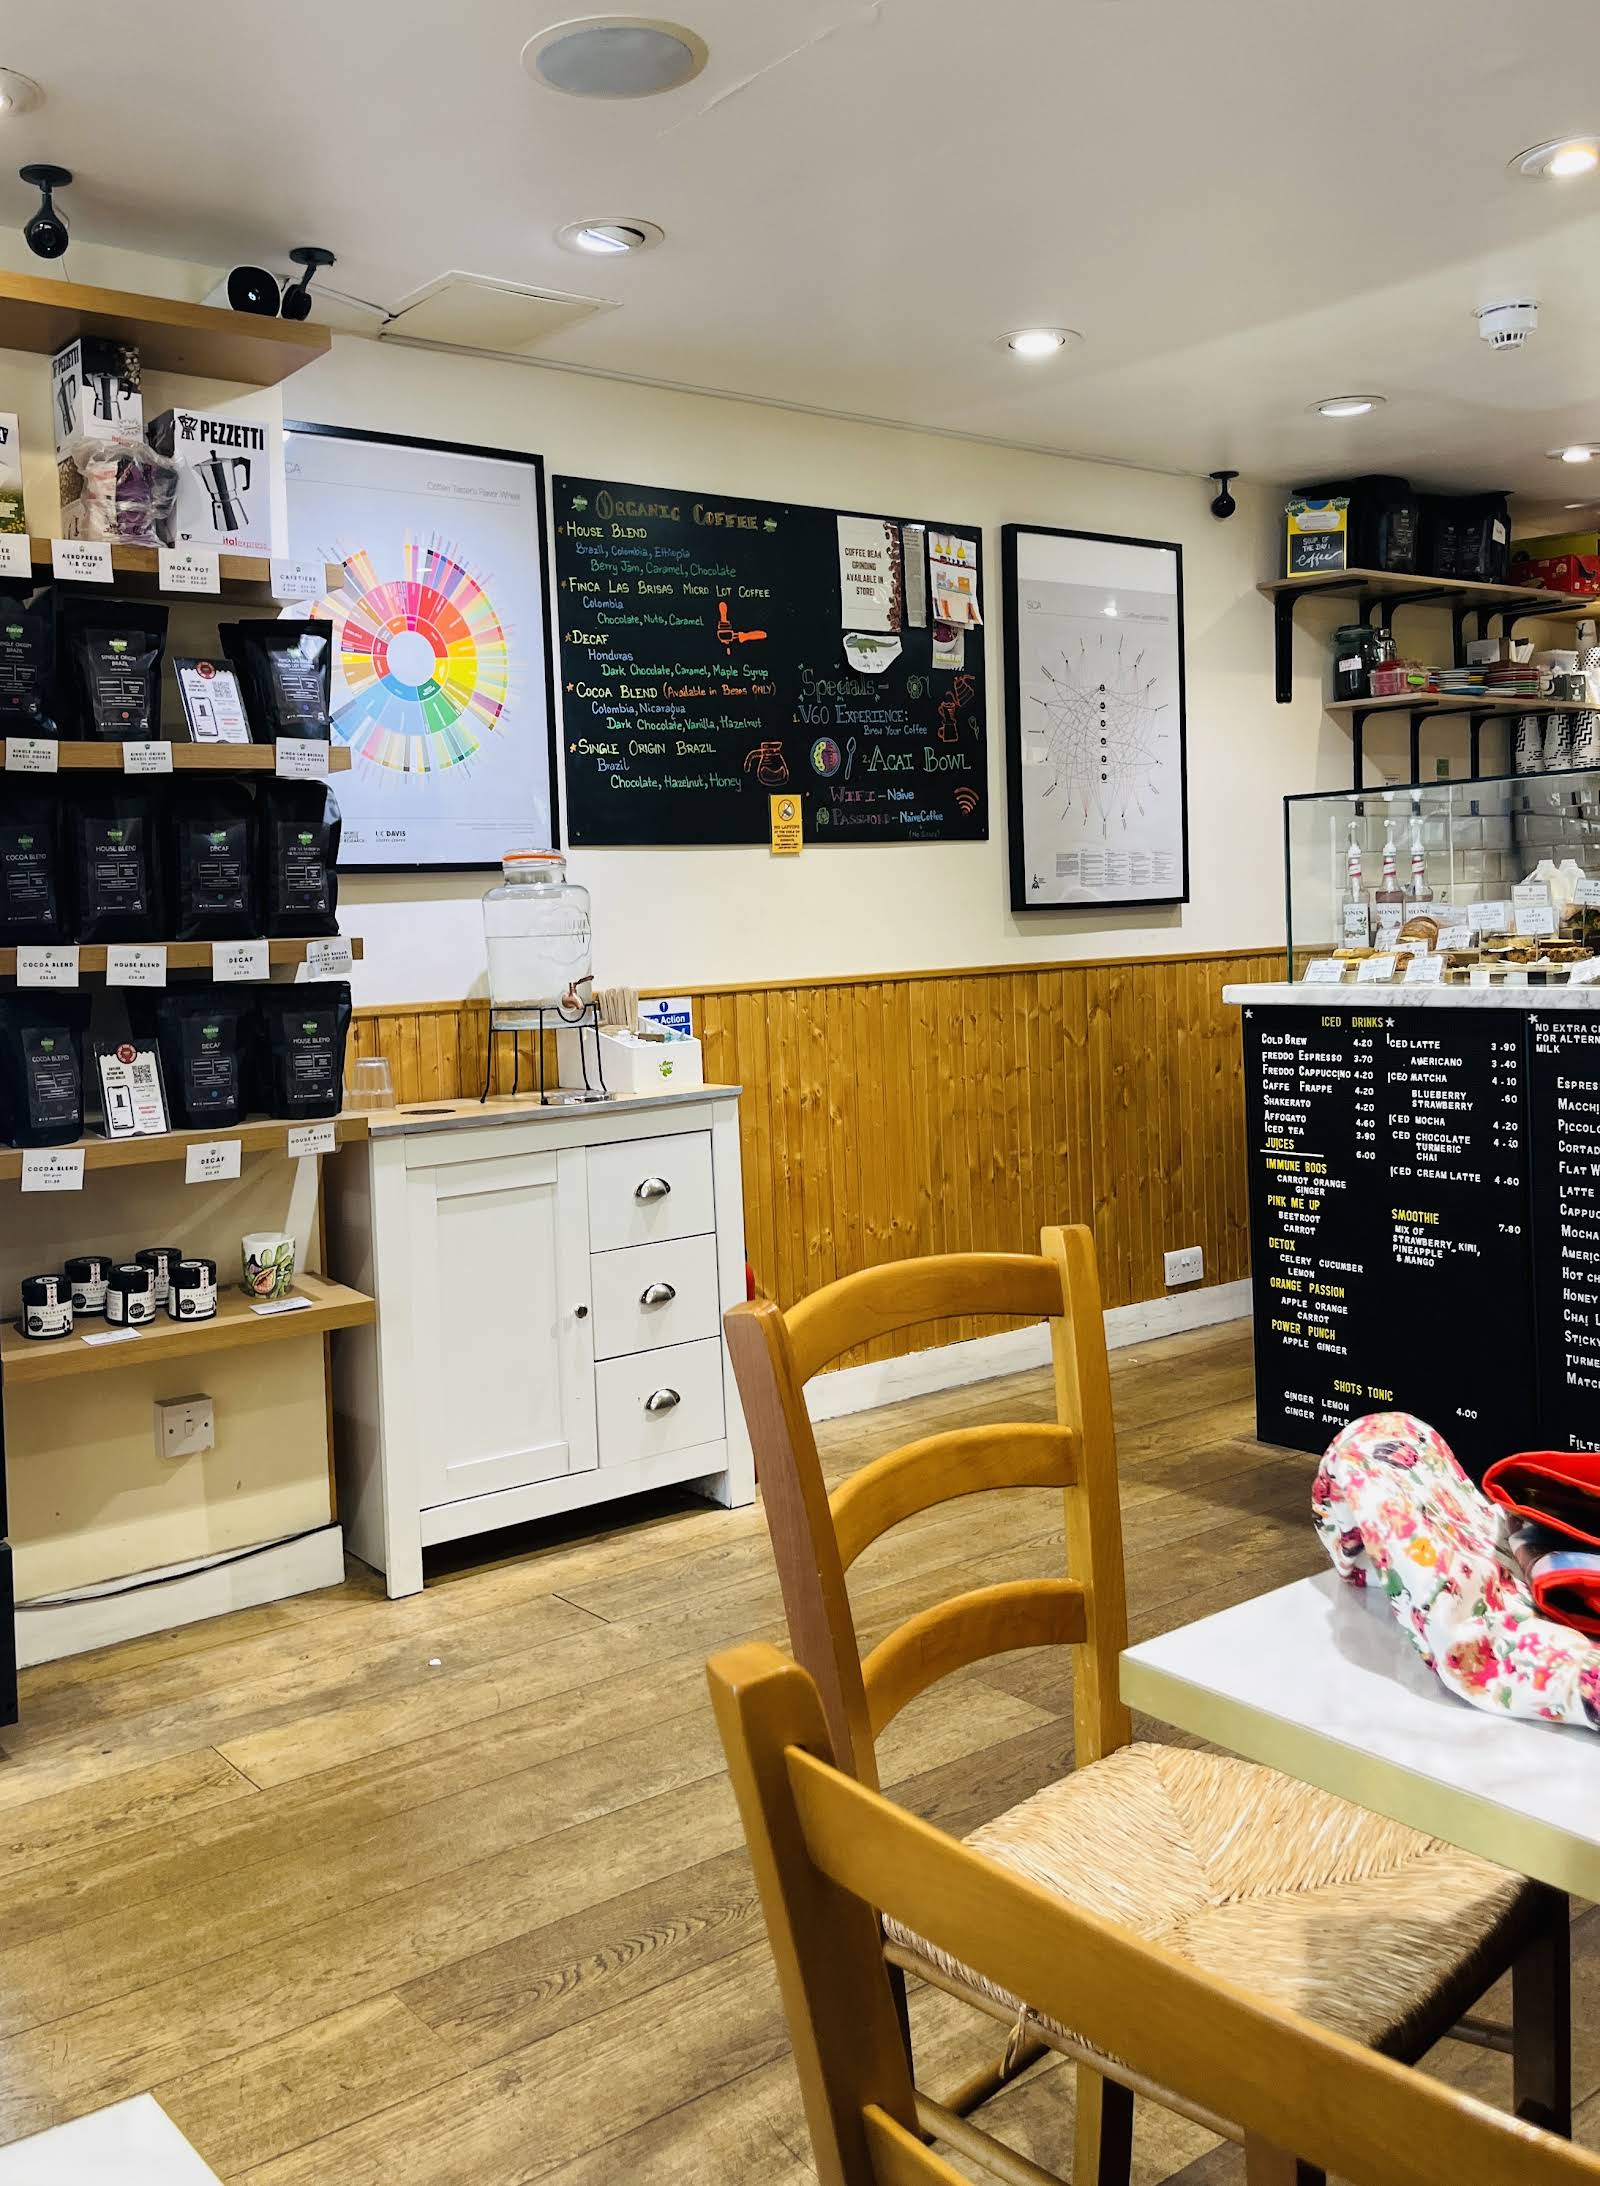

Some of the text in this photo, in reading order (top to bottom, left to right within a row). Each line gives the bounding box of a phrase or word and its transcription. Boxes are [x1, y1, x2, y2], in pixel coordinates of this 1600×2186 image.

[201, 420, 264, 450] PEZZETTI
[595, 490, 758, 530] ORGANIC COFFEE
[567, 521, 647, 538] HOUSE BLEND
[845, 548, 881, 558] COFFEE BEAN
[1296, 550, 1342, 567] Coffee
[591, 560, 736, 577] Berry Chocolate
[852, 562, 876, 570] GRINDING
[847, 574, 877, 583] AVAILABLE
[569, 578, 770, 598] FINCA LAS BRISAS MICRO LOT COFFEE
[583, 596, 624, 609] Colombia
[598, 613, 704, 626] Chocolate, Caramel
[572, 630, 609, 645] DECAF
[588, 649, 633, 661] Honduras
[601, 665, 768, 680] Dark Chocolate, Maple Syrup
[576, 682, 657, 698] COCOA BLEND
[592, 702, 686, 720] Colombia, Nicaragua
[607, 717, 762, 732] Dark Chocolate, Hazelnut
[904, 725, 927, 734] Coffee
[578, 739, 716, 755] SINGLE ORIGIN BRAZIL
[598, 758, 630, 772] Brazil
[923, 747, 971, 772] BOWL
[611, 774, 741, 792] Chocolate, Honey
[661, 1016, 685, 1024] Action
[1322, 1016, 1383, 1028] ICED DRINKS
[1553, 1024, 1587, 1032] EXTRA
[1262, 1033, 1307, 1045] COLD BREW
[1353, 1039, 1372, 1047] 4.20
[1410, 1041, 1440, 1049] LATTE
[1537, 1034, 1556, 1043] FOR
[1536, 1044, 1560, 1053] MILK
[1262, 1050, 1373, 1063] FREDDO ESPRESSO 3.70
[1411, 1057, 1463, 1066] AMERICANO
[1263, 1064, 1373, 1080] FREDDO CAPPUCCINO 4.20
[1410, 1073, 1447, 1083] MATCHA
[1263, 1079, 1374, 1095] CAFFE FRAPPE 4.20
[1412, 1090, 1467, 1100] BLUEBERRY
[1263, 1095, 1374, 1111] SHAKERATO 4.20
[1412, 1100, 1473, 1111] STRAWBERRY
[1264, 1110, 1375, 1128] AFFOGATO 4.60
[1415, 1116, 1445, 1126] MOCHA
[1265, 1122, 1375, 1140] ICED TEA 3.90
[1415, 1133, 1471, 1144] CHOCOLATE
[1265, 1137, 1375, 1160] JUICES 6.00
[1416, 1143, 1461, 1153] TURMERIC
[1416, 1153, 1438, 1161] CHAI
[1266, 1158, 1327, 1174] IMMUNE BOOS
[1277, 1175, 1346, 1189] CARROT ORANGE
[1417, 1169, 1481, 1183] CREAM LATTE
[1295, 1186, 1325, 1196] GINGER
[1560, 1186, 1594, 1198] LATTE
[1268, 1195, 1320, 1211] PINK ME UP
[1279, 1211, 1321, 1223] BEETROOT
[1391, 1209, 1439, 1224] SMOOTHIE
[1283, 1224, 1316, 1235] CARROT
[1395, 1225, 1424, 1235] MIX OF
[1499, 1224, 1521, 1234] 7.80
[1561, 1224, 1600, 1240] MOCHA
[1269, 1237, 1295, 1251] DETOX
[1393, 1244, 1443, 1258] PINEAPPLE
[1279, 1254, 1364, 1273] CELERY CUCUMBER
[1404, 1256, 1434, 1267] MANGO
[1288, 1267, 1315, 1278] LEMON
[1270, 1277, 1345, 1298] ORANGE PASSION
[1563, 1288, 1598, 1304] HONEY
[1281, 1296, 1348, 1315] APPLE ORANGE
[1297, 1312, 1330, 1324] CARROT
[1272, 1320, 1336, 1340] POWER PUNCH
[1283, 1336, 1347, 1355] APPLE GINGER
[1334, 1380, 1394, 1402] SHOTS TONIC
[1284, 1391, 1350, 1411] GINGER LEMON
[1285, 1406, 1315, 1420] GINGER
[1456, 1407, 1478, 1419] 4.00
